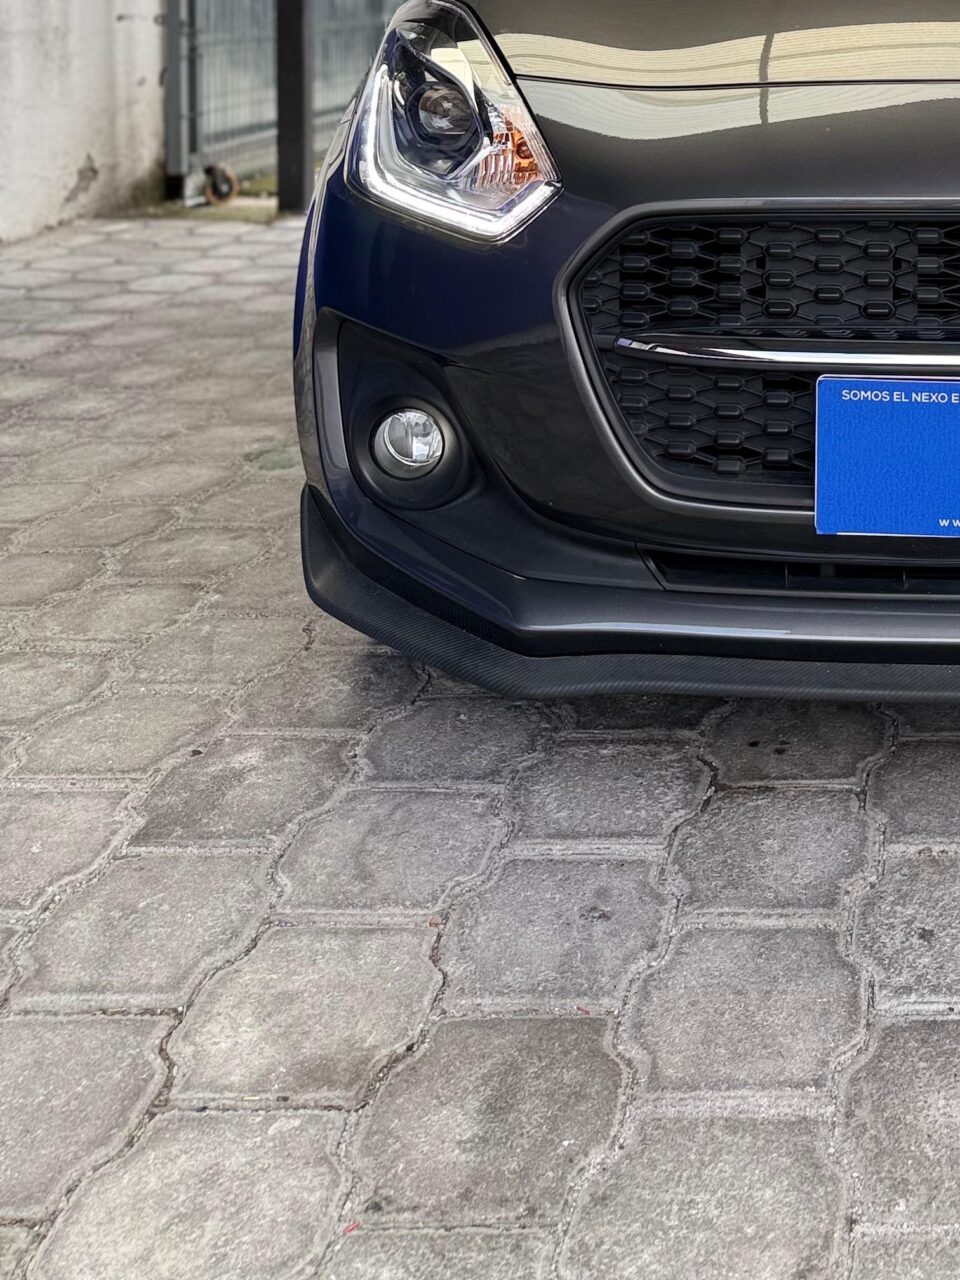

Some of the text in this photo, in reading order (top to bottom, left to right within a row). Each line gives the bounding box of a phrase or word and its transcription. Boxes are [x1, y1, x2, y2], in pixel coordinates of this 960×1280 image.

[841, 389, 890, 402] SOMOS
[893, 391, 909, 402] EL
[911, 392, 949, 403] NEXO
